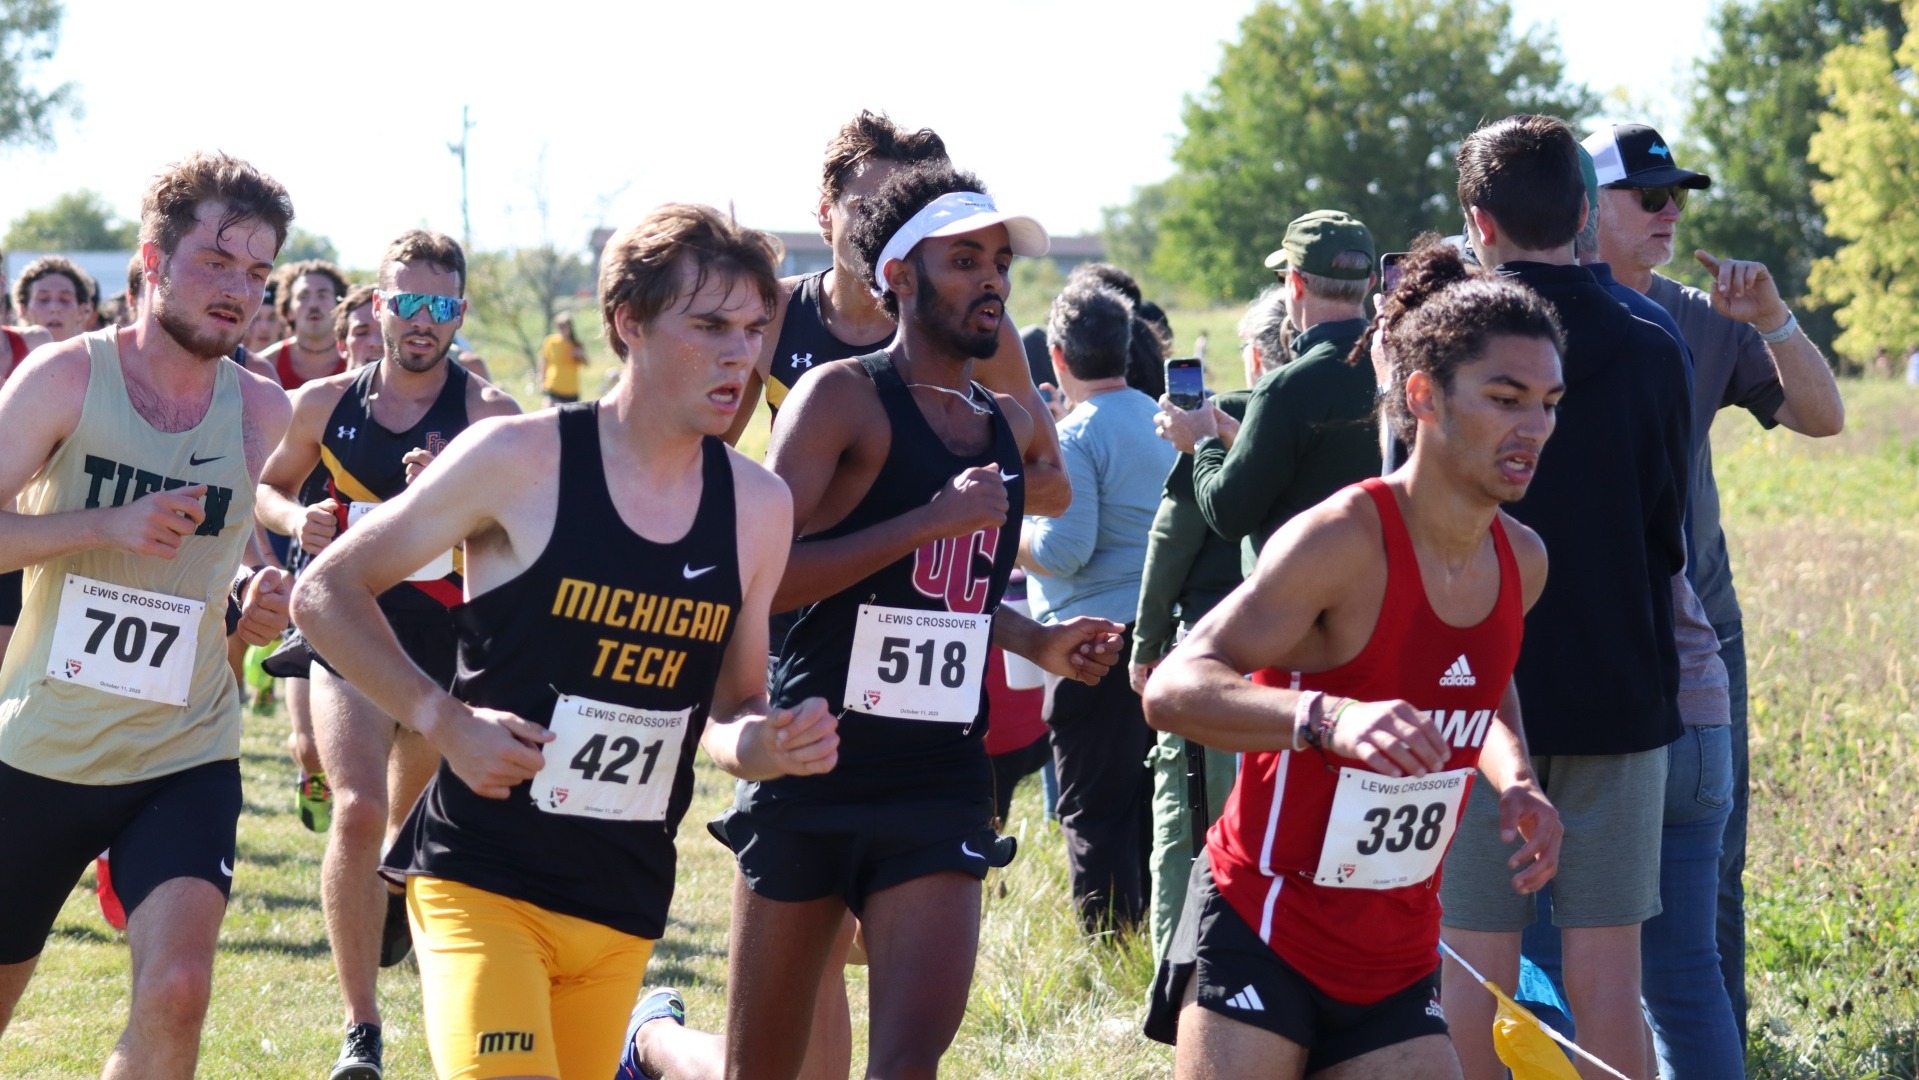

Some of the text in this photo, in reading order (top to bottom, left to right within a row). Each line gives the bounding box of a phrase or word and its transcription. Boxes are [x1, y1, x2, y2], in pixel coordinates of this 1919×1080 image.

[84, 454, 233, 537] TIFN
[83, 584, 191, 615] LEWIS CROSSOVER
[551, 577, 731, 643] MICHIGAN
[84, 607, 180, 668] 707
[877, 613, 977, 629] LEWIS CROSSOVER
[592, 638, 687, 688] TECH
[877, 636, 967, 689] 518
[1439, 674, 1476, 686] adidas
[100, 681, 120, 690] October
[577, 705, 682, 728] LEWIS CROSSOVER
[569, 733, 664, 785] 421
[1361, 777, 1460, 795] LEWIS CROSSOVER
[1356, 801, 1447, 856] 338
[480, 1031, 534, 1054] MTU
